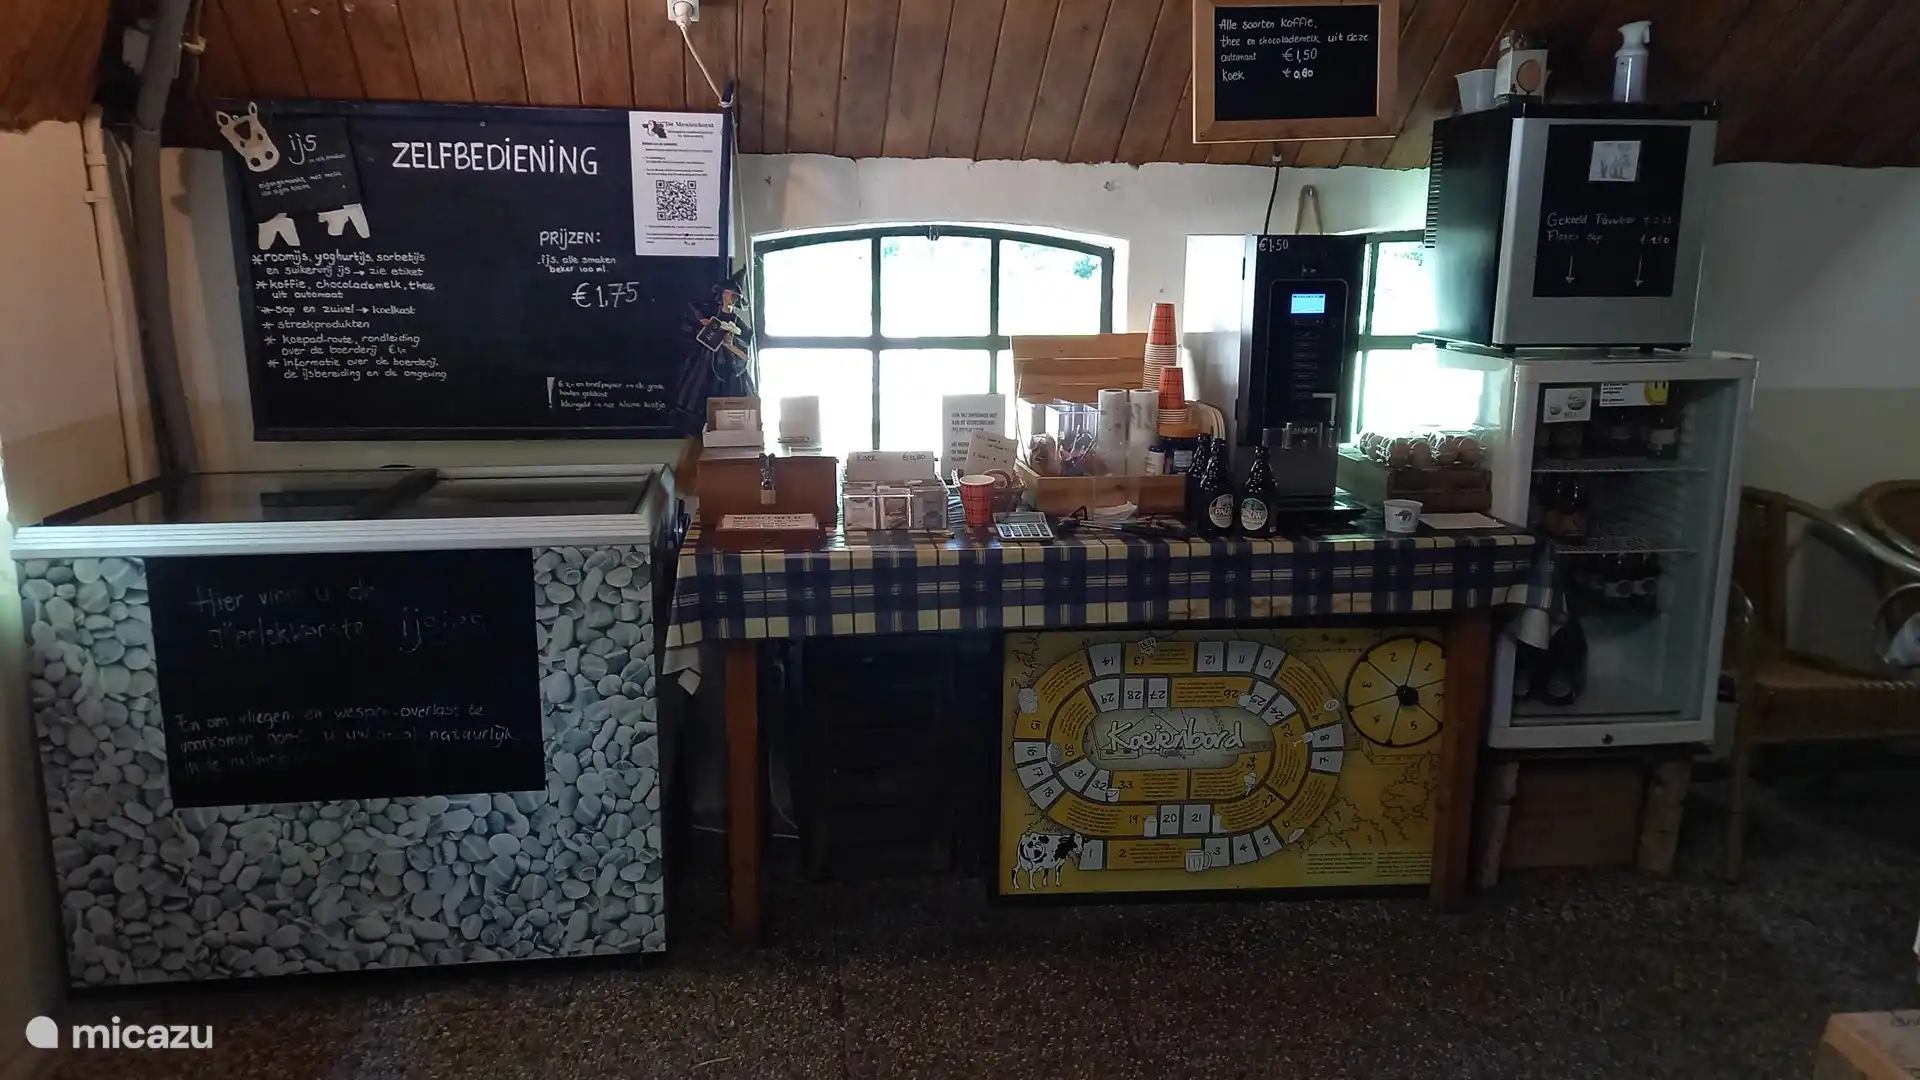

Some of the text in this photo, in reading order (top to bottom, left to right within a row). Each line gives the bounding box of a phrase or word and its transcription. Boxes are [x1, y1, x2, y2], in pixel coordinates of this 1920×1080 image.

[1219, 18, 1237, 31] Alle
[1242, 19, 1275, 30] soorten
[1219, 32, 1369, 48] thee en chocolademelk uit deze
[376, 251, 426, 265] sorbetijs
[562, 255, 580, 265] alle
[581, 255, 616, 265] smaken
[266, 267, 280, 276] en
[336, 265, 352, 277] ijs
[369, 267, 388, 276] zie
[391, 267, 424, 276] etiket
[549, 265, 574, 273] beker
[271, 291, 344, 300] uit automaat
[302, 305, 316, 314] en
[322, 303, 355, 314] zuivel
[372, 304, 416, 316] koelkast
[277, 319, 371, 332] streekprodukten
[361, 333, 420, 348] rondleiding
[281, 346, 306, 356] over
[310, 345, 325, 355] de
[347, 358, 369, 366] over
[376, 357, 390, 366] de
[283, 369, 299, 379] de
[366, 370, 380, 378] en
[384, 368, 398, 377] de
[404, 370, 448, 382] omgeving
[188, 585, 246, 618] Hier
[1101, 656, 1114, 667] 14
[1204, 654, 1216, 666] 12
[1388, 652, 1398, 663] 2
[1100, 692, 1115, 704] 29
[1127, 690, 1142, 700] 28
[1149, 689, 1166, 700] 27
[1249, 694, 1267, 707] 25
[1269, 706, 1285, 720] 24
[206, 716, 230, 729] om
[1409, 720, 1418, 731] 5
[1107, 716, 1244, 752] Koeienbord
[1319, 733, 1330, 741] 8
[1027, 745, 1037, 756] 16
[1064, 744, 1075, 757] 30
[1091, 780, 1107, 791] 32
[1119, 780, 1133, 789] 33
[1163, 813, 1178, 823] 20
[1191, 813, 1202, 823] 21
[1118, 849, 1127, 858] 2
[1212, 847, 1221, 856] 3
